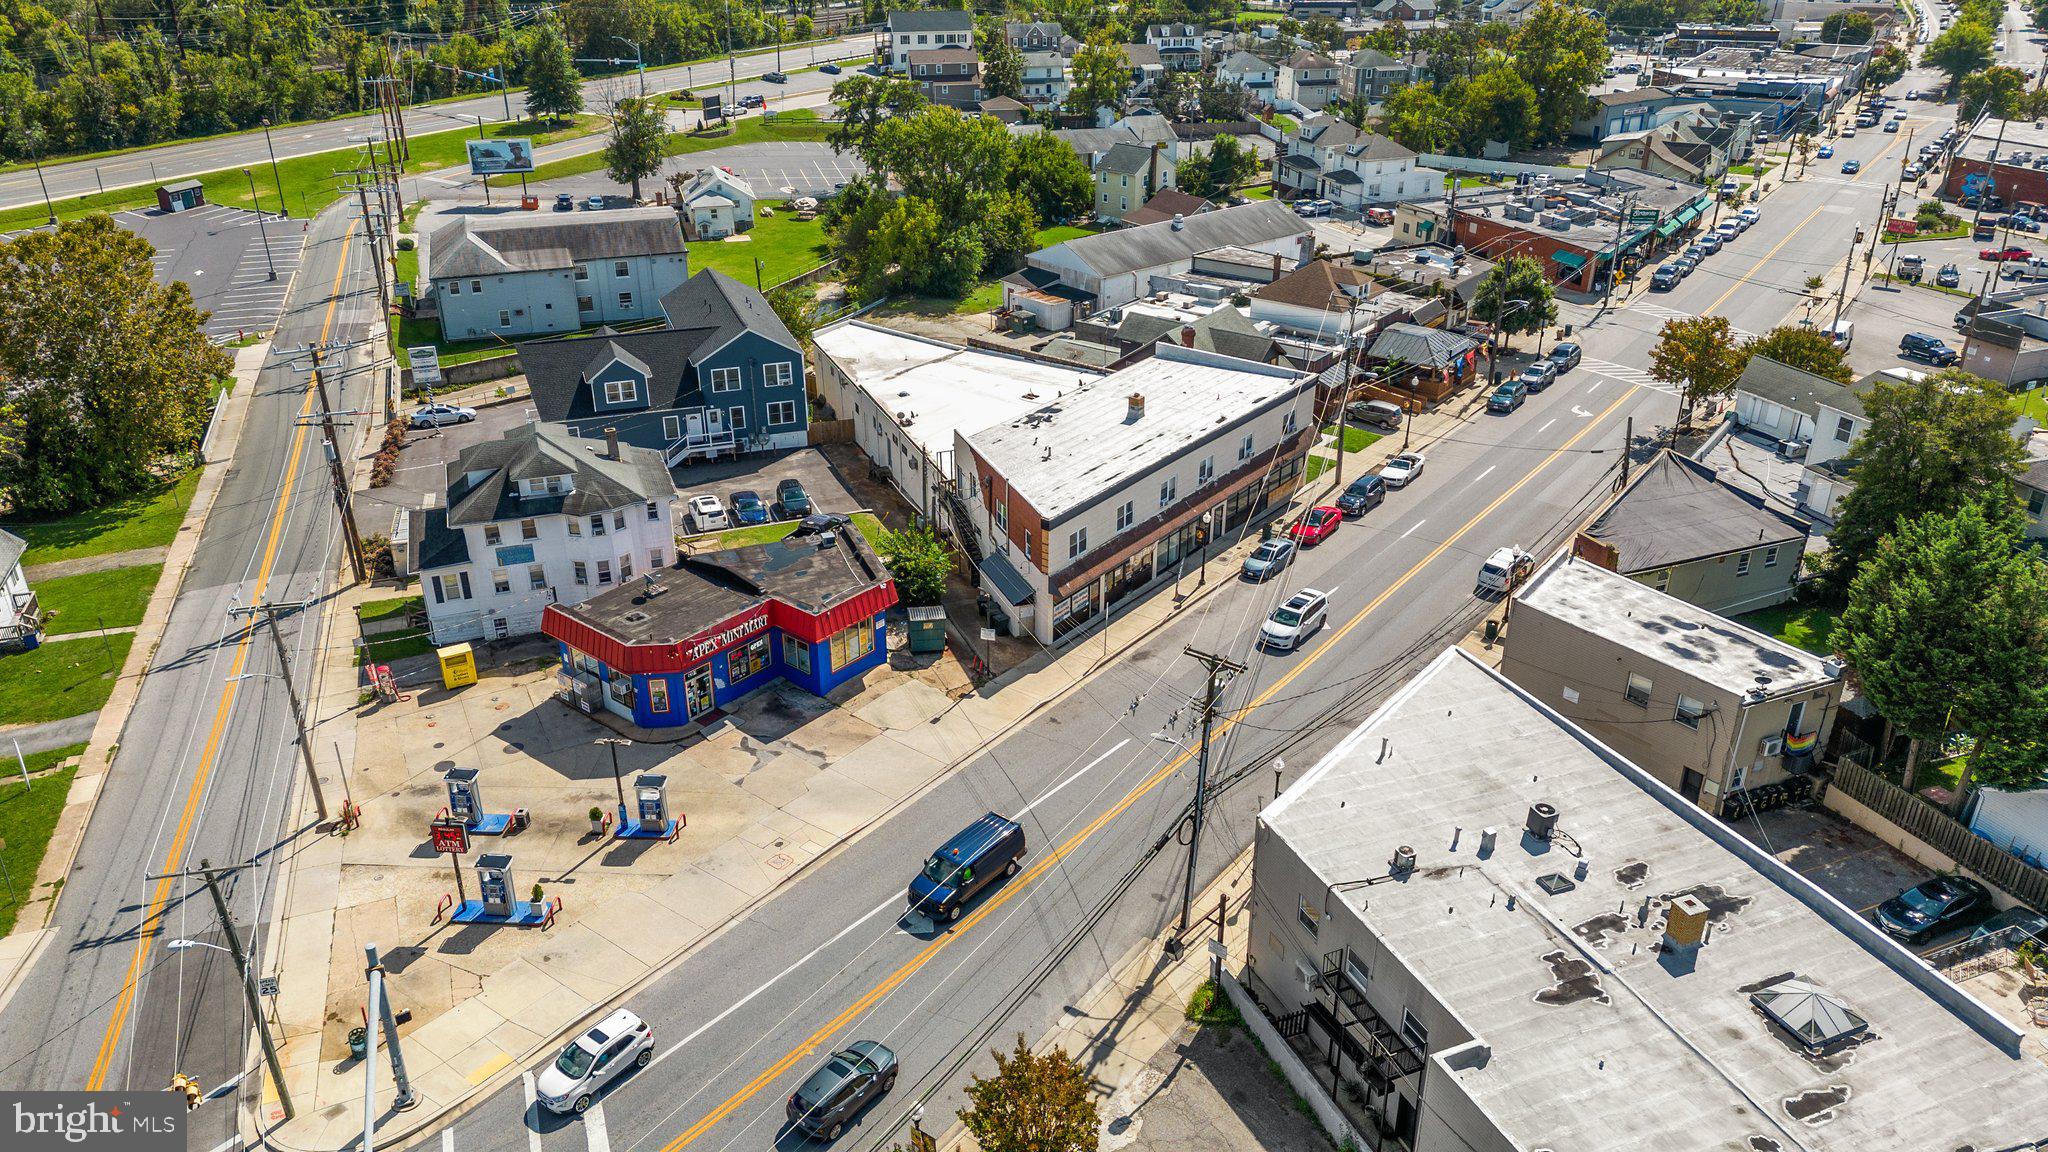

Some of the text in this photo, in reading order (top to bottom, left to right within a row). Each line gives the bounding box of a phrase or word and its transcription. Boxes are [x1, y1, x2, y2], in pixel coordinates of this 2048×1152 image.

[720, 625, 744, 647] MINI
[743, 614, 769, 635] MART
[438, 839, 460, 848] ATM
[261, 985, 278, 995] 25
